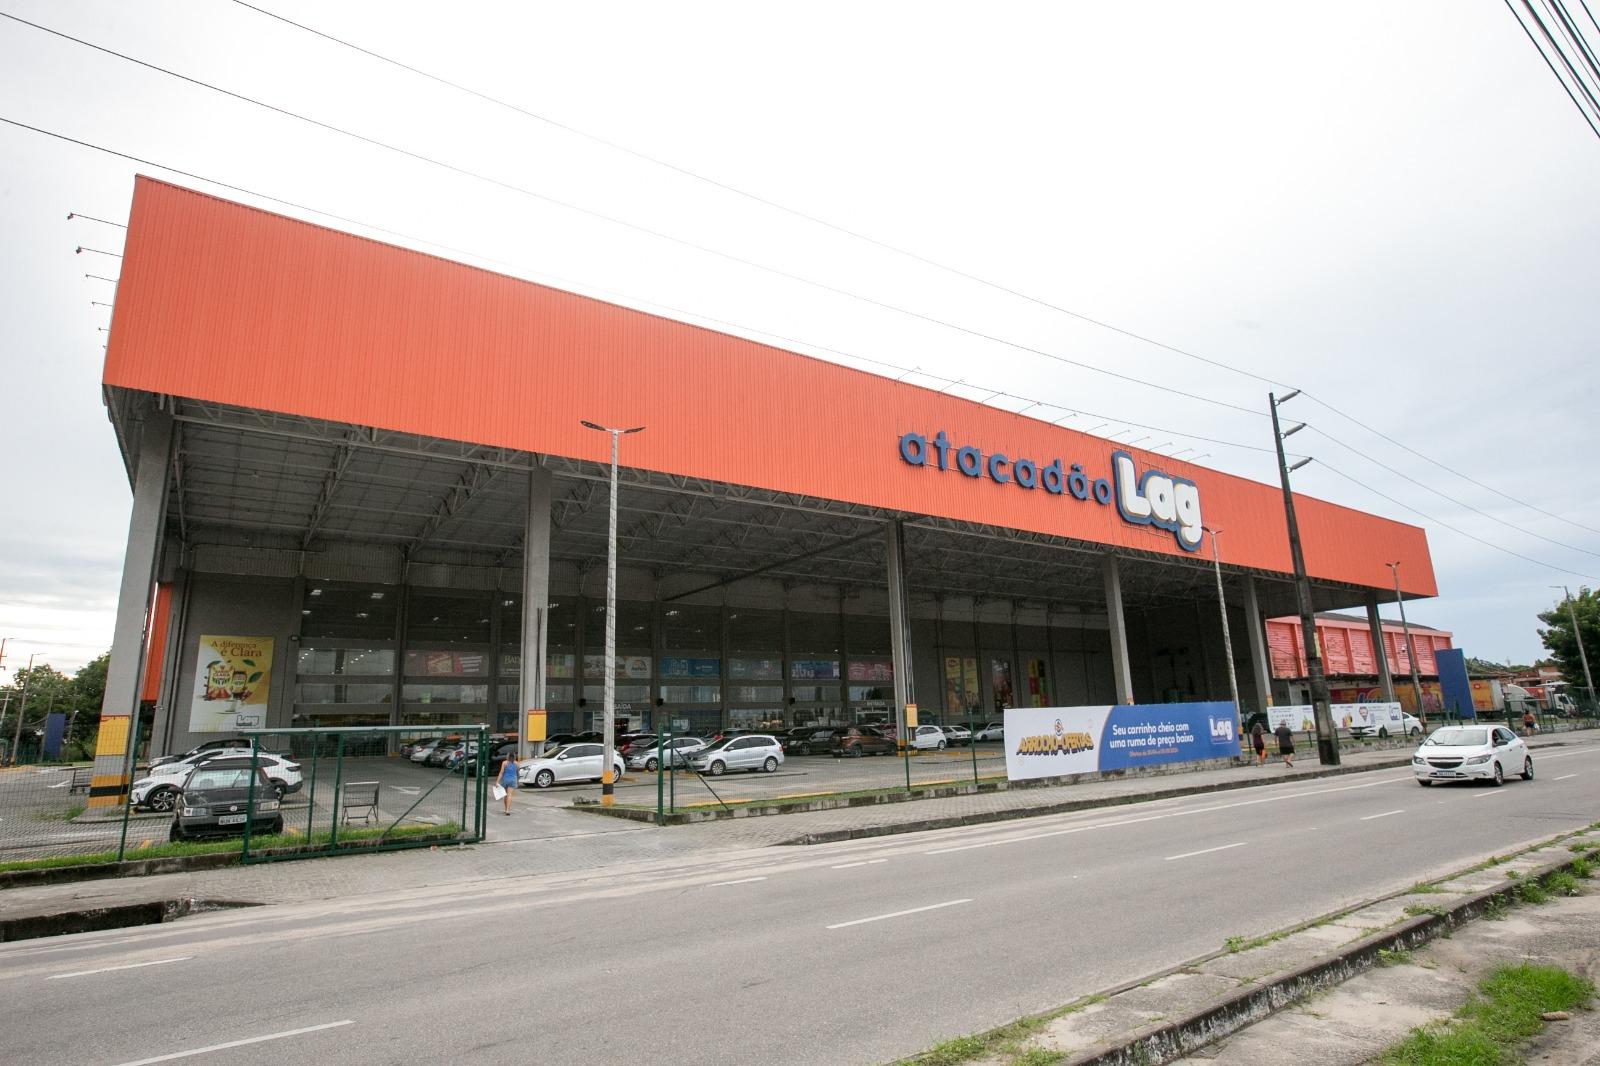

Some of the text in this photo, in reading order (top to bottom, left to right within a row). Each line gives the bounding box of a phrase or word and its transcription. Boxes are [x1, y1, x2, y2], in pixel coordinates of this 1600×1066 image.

[899, 430, 1203, 546] atacadão Lag
[231, 647, 262, 657] Clara
[1112, 721, 1189, 736] Seu carrinho cheio com
[1209, 718, 1232, 740] Lag
[1062, 733, 1094, 755] OFERTAS
[1109, 732, 1194, 749] uma ruma de preço baixo
